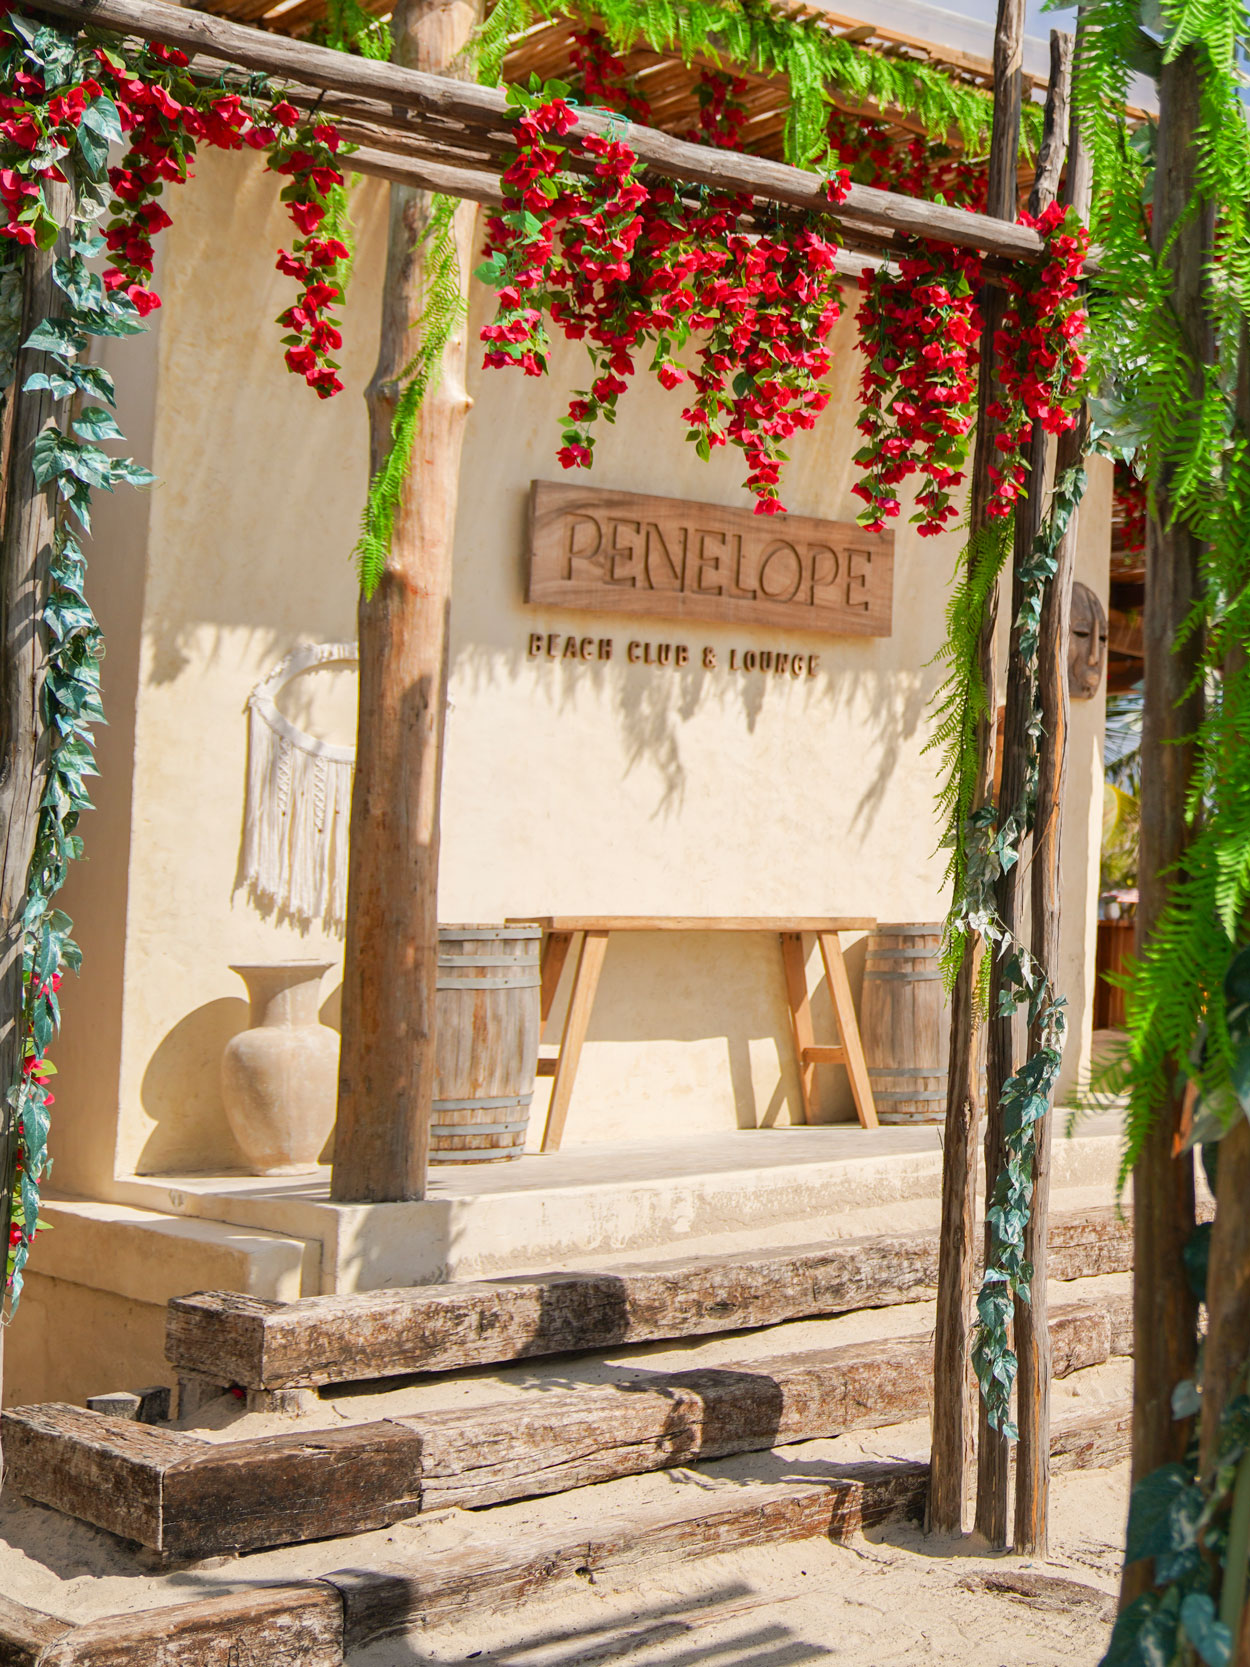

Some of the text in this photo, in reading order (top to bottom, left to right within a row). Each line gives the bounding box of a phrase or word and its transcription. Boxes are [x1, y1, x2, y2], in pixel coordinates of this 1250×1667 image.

[561, 512, 872, 612] PENELOPE
[529, 632, 821, 677] BEACH CLUB & LOUNGE
